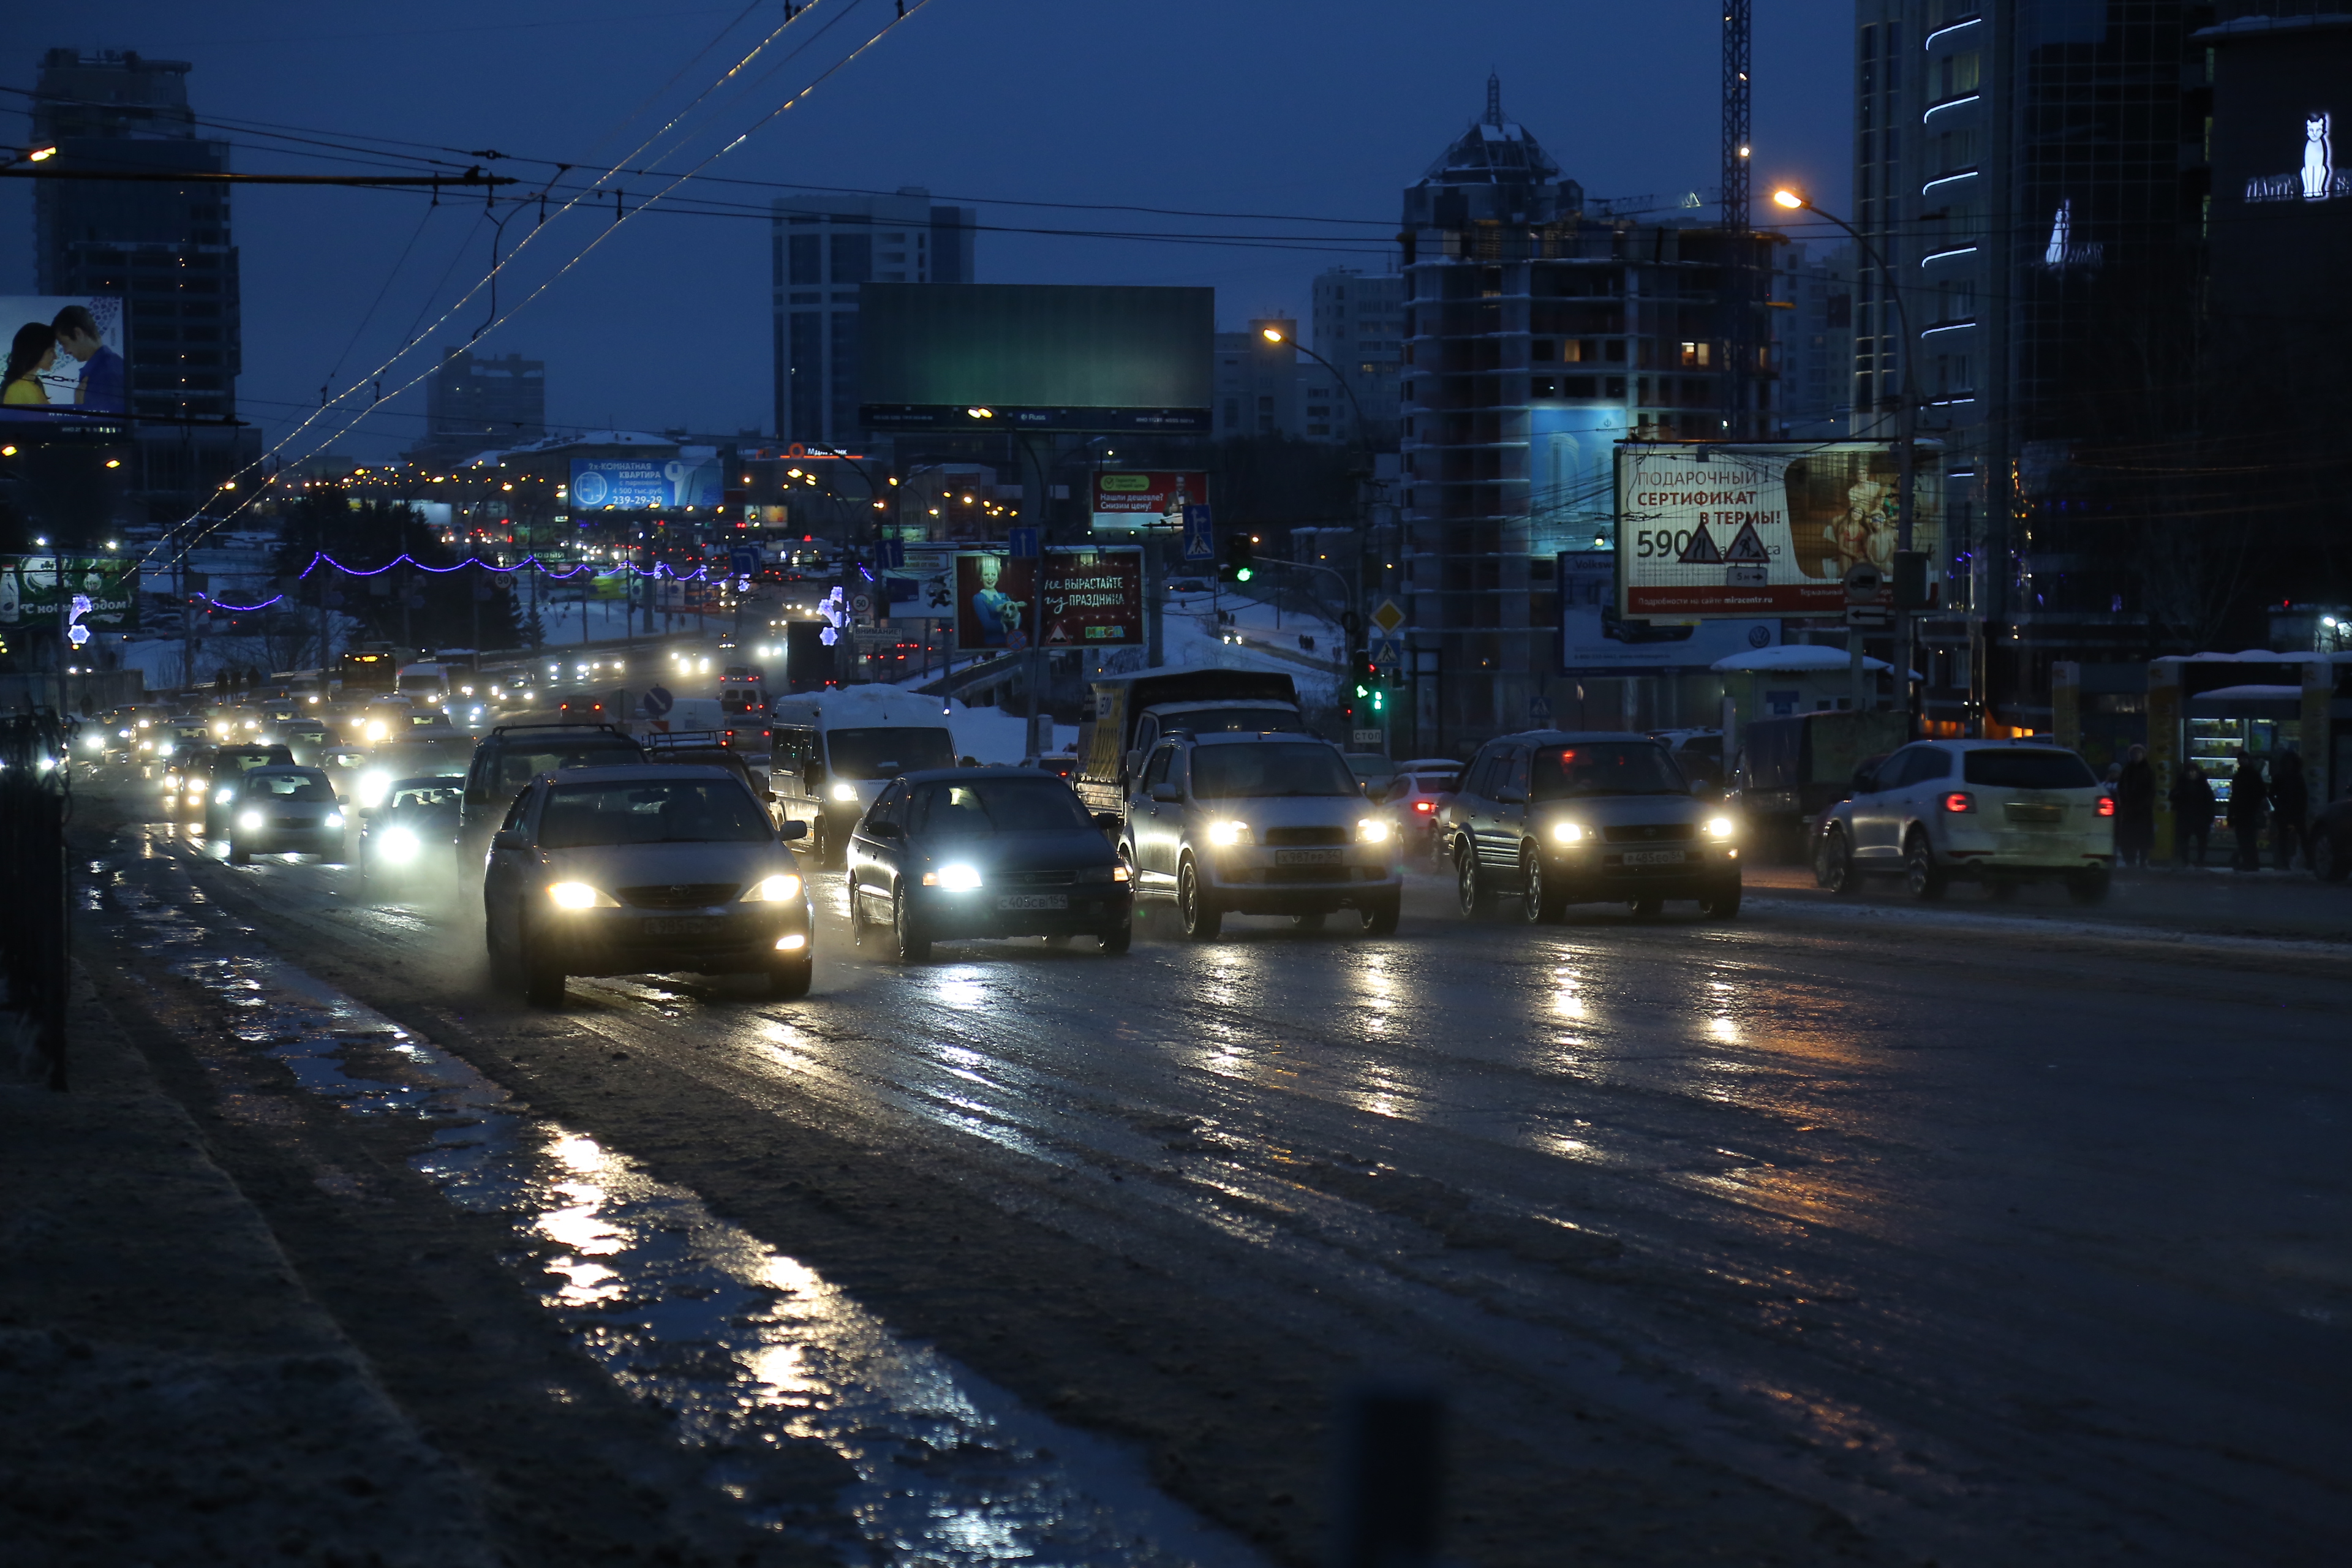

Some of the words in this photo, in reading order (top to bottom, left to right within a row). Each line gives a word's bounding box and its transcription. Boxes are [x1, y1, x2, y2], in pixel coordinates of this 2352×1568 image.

[619, 469, 662, 478] КВАРТИРА
[1638, 471, 1757, 488] ПОДАРОЧНЫЙ
[612, 495, 663, 505] 239-29-29
[1127, 493, 1164, 502] дешевле?
[1637, 491, 1757, 506] СЕРТИФИКАТ
[1131, 502, 1152, 511] цену!
[1700, 511, 1709, 524] В
[1714, 510, 1781, 525] ТЕРМЫ!
[497, 576, 509, 584] 50
[1044, 579, 1063, 590] не
[1065, 576, 1123, 590] ВЫРАСТАЙТЕ
[1800, 588, 1844, 597] Термальный
[856, 599, 866, 608] 50
[1044, 597, 1069, 614] из
[1069, 593, 1125, 607] ПРАЗДНИКА
[1638, 597, 1689, 606] Подробности
[1354, 732, 1381, 741] СТОП
[1049, 895, 1066, 905] 154
